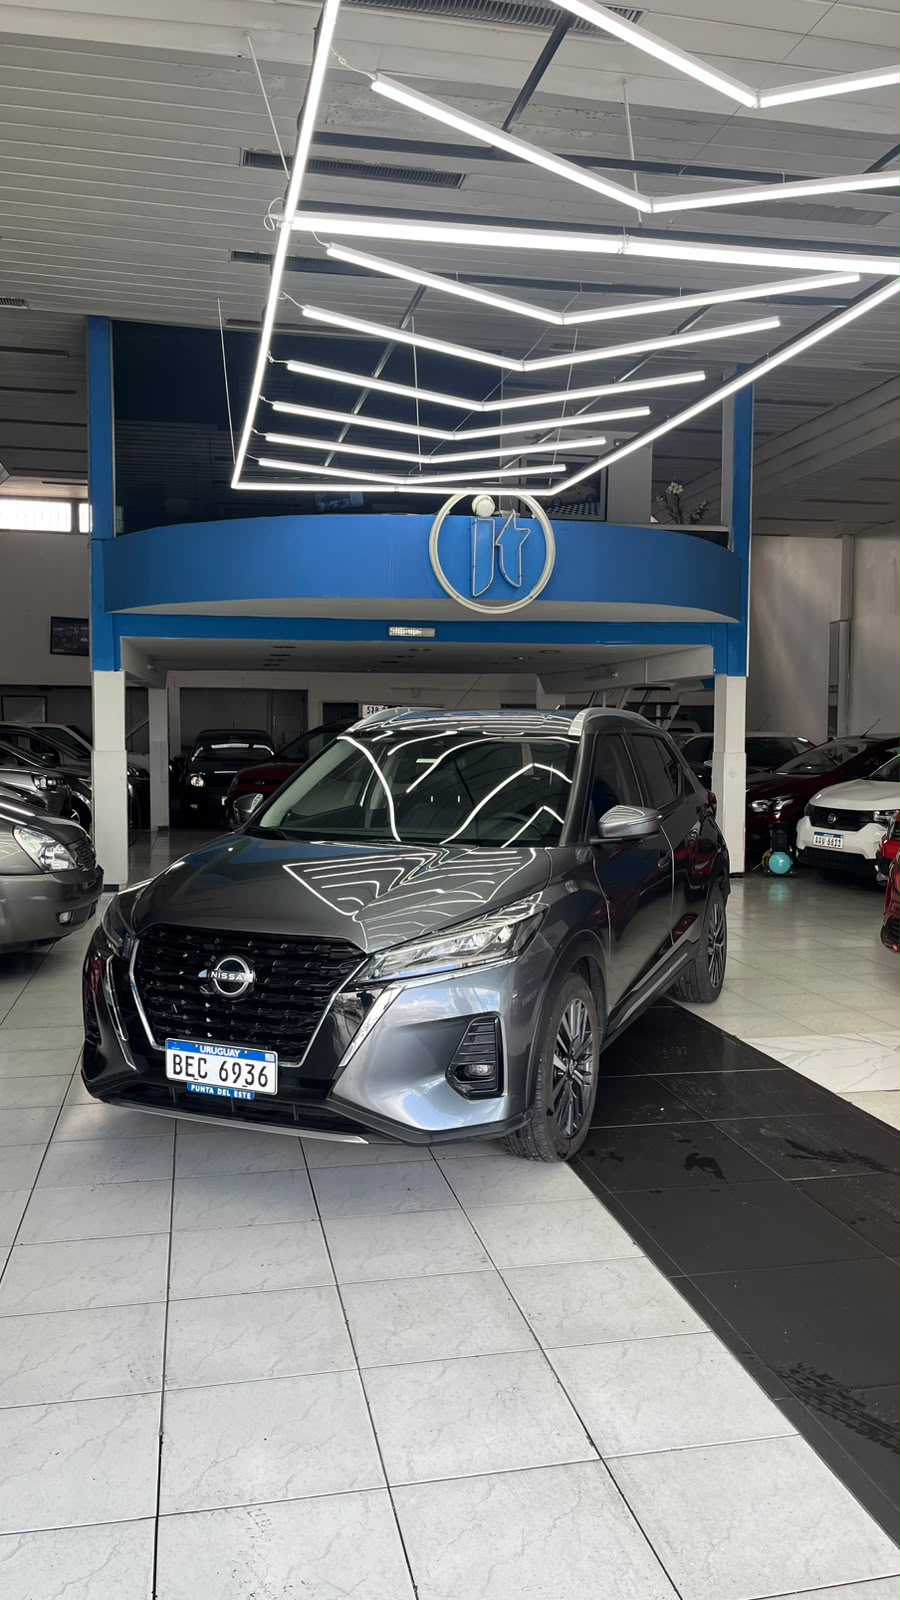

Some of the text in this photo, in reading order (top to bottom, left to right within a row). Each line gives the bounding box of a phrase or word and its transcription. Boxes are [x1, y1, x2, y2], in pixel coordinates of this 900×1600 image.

[211, 971, 253, 982] NISSA
[199, 1045, 240, 1057] URUGUAY
[172, 1053, 268, 1088] BEC 6936
[190, 1084, 251, 1099] PUNTA DEL ESTE
